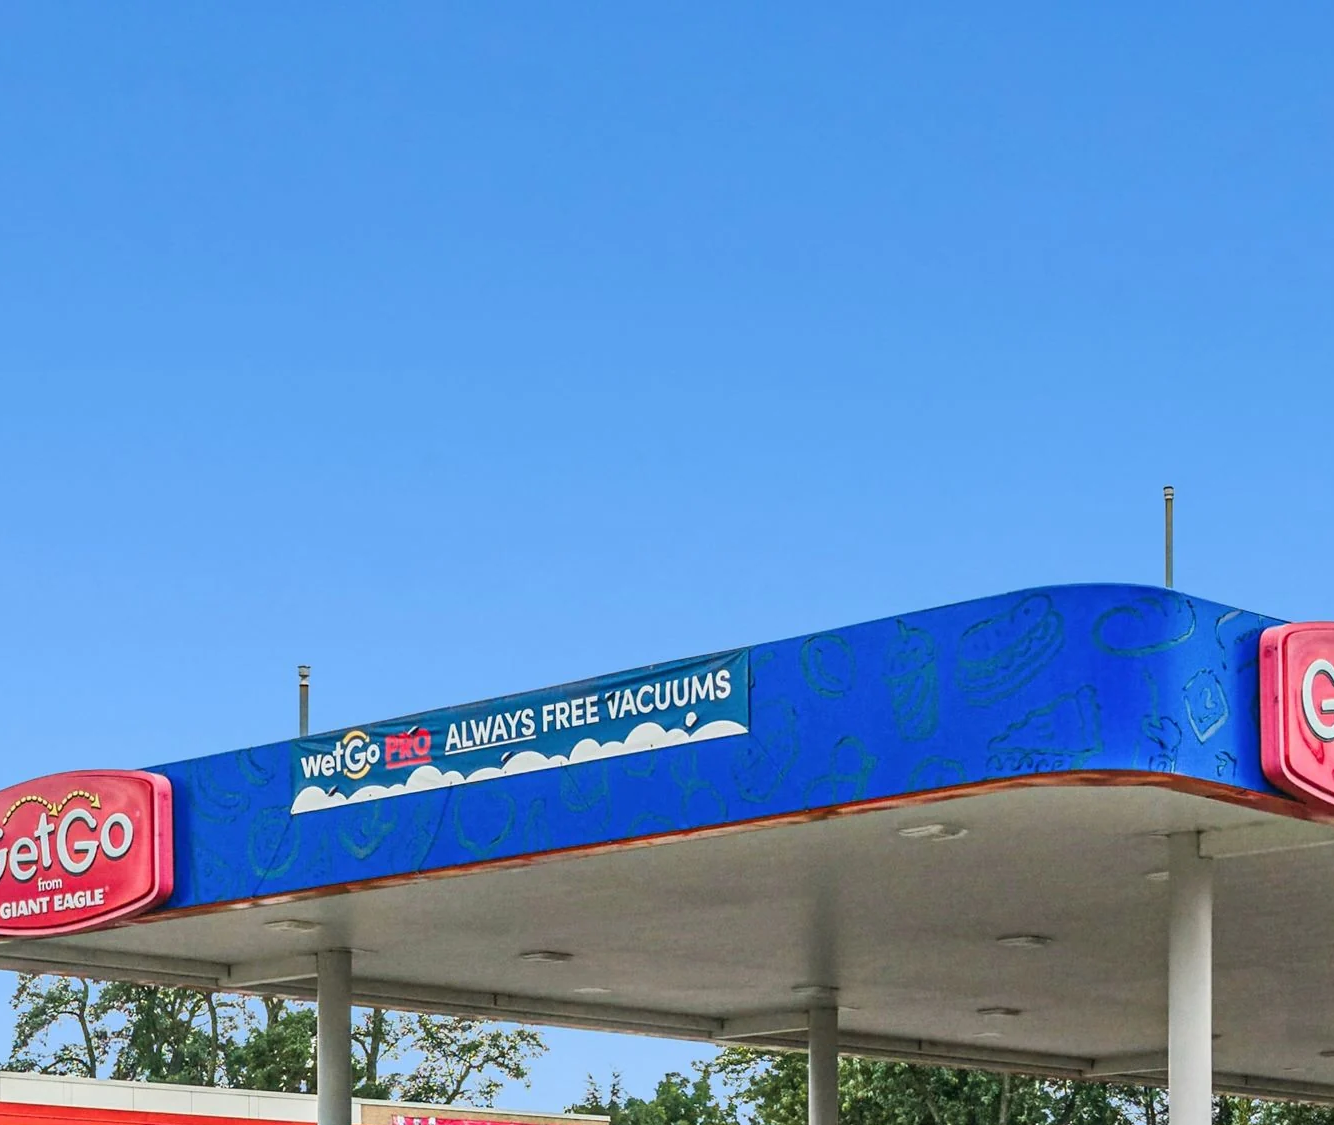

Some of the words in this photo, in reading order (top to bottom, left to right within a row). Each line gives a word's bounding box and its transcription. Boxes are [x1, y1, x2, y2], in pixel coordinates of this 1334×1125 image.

[301, 740, 380, 779] wetGo
[384, 728, 432, 765] PRO
[445, 708, 535, 750] ALWAYS
[542, 695, 599, 733] FREE
[607, 669, 732, 720] VACUUMS
[38, 877, 63, 892] from
[0, 896, 50, 920] GIANT
[53, 887, 105, 912] EAGLE
